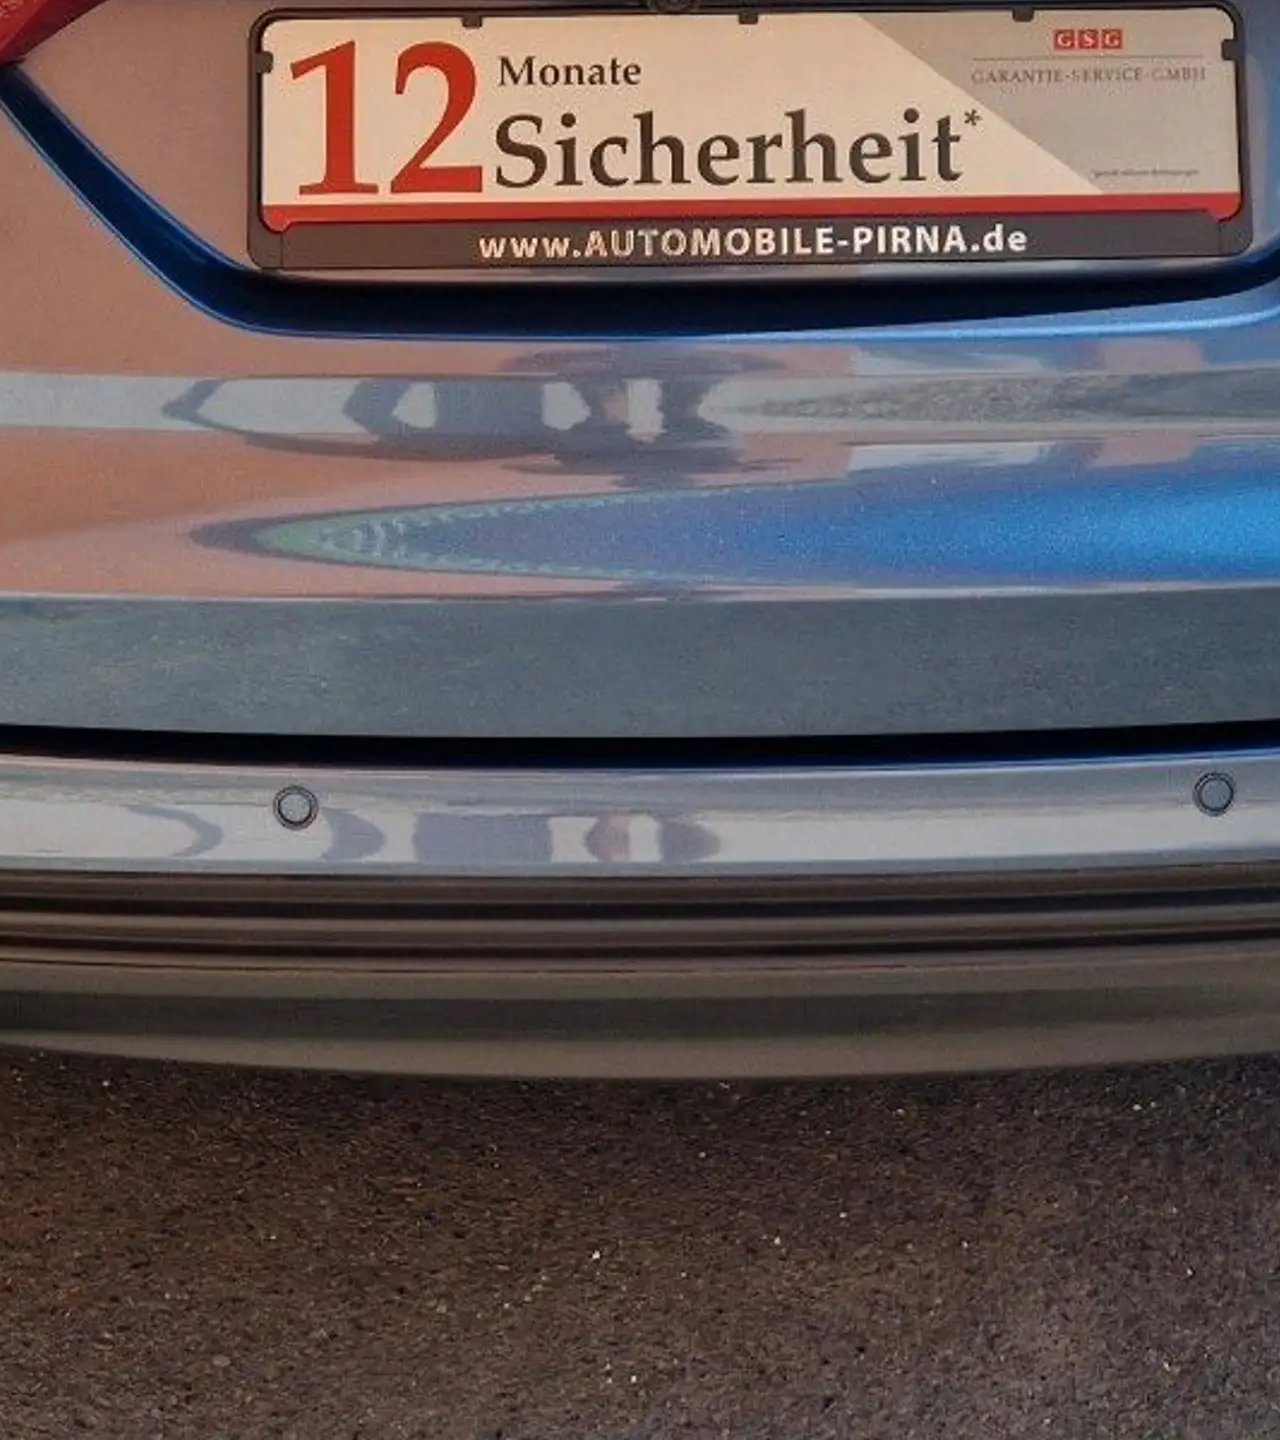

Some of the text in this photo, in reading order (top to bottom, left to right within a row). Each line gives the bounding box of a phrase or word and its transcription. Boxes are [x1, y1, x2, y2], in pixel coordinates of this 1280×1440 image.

[1055, 31, 1121, 48] GSG
[289, 39, 642, 195] 12 Monate
[478, 223, 1028, 260] www.AUTOMOBILE-PIRNA.de
